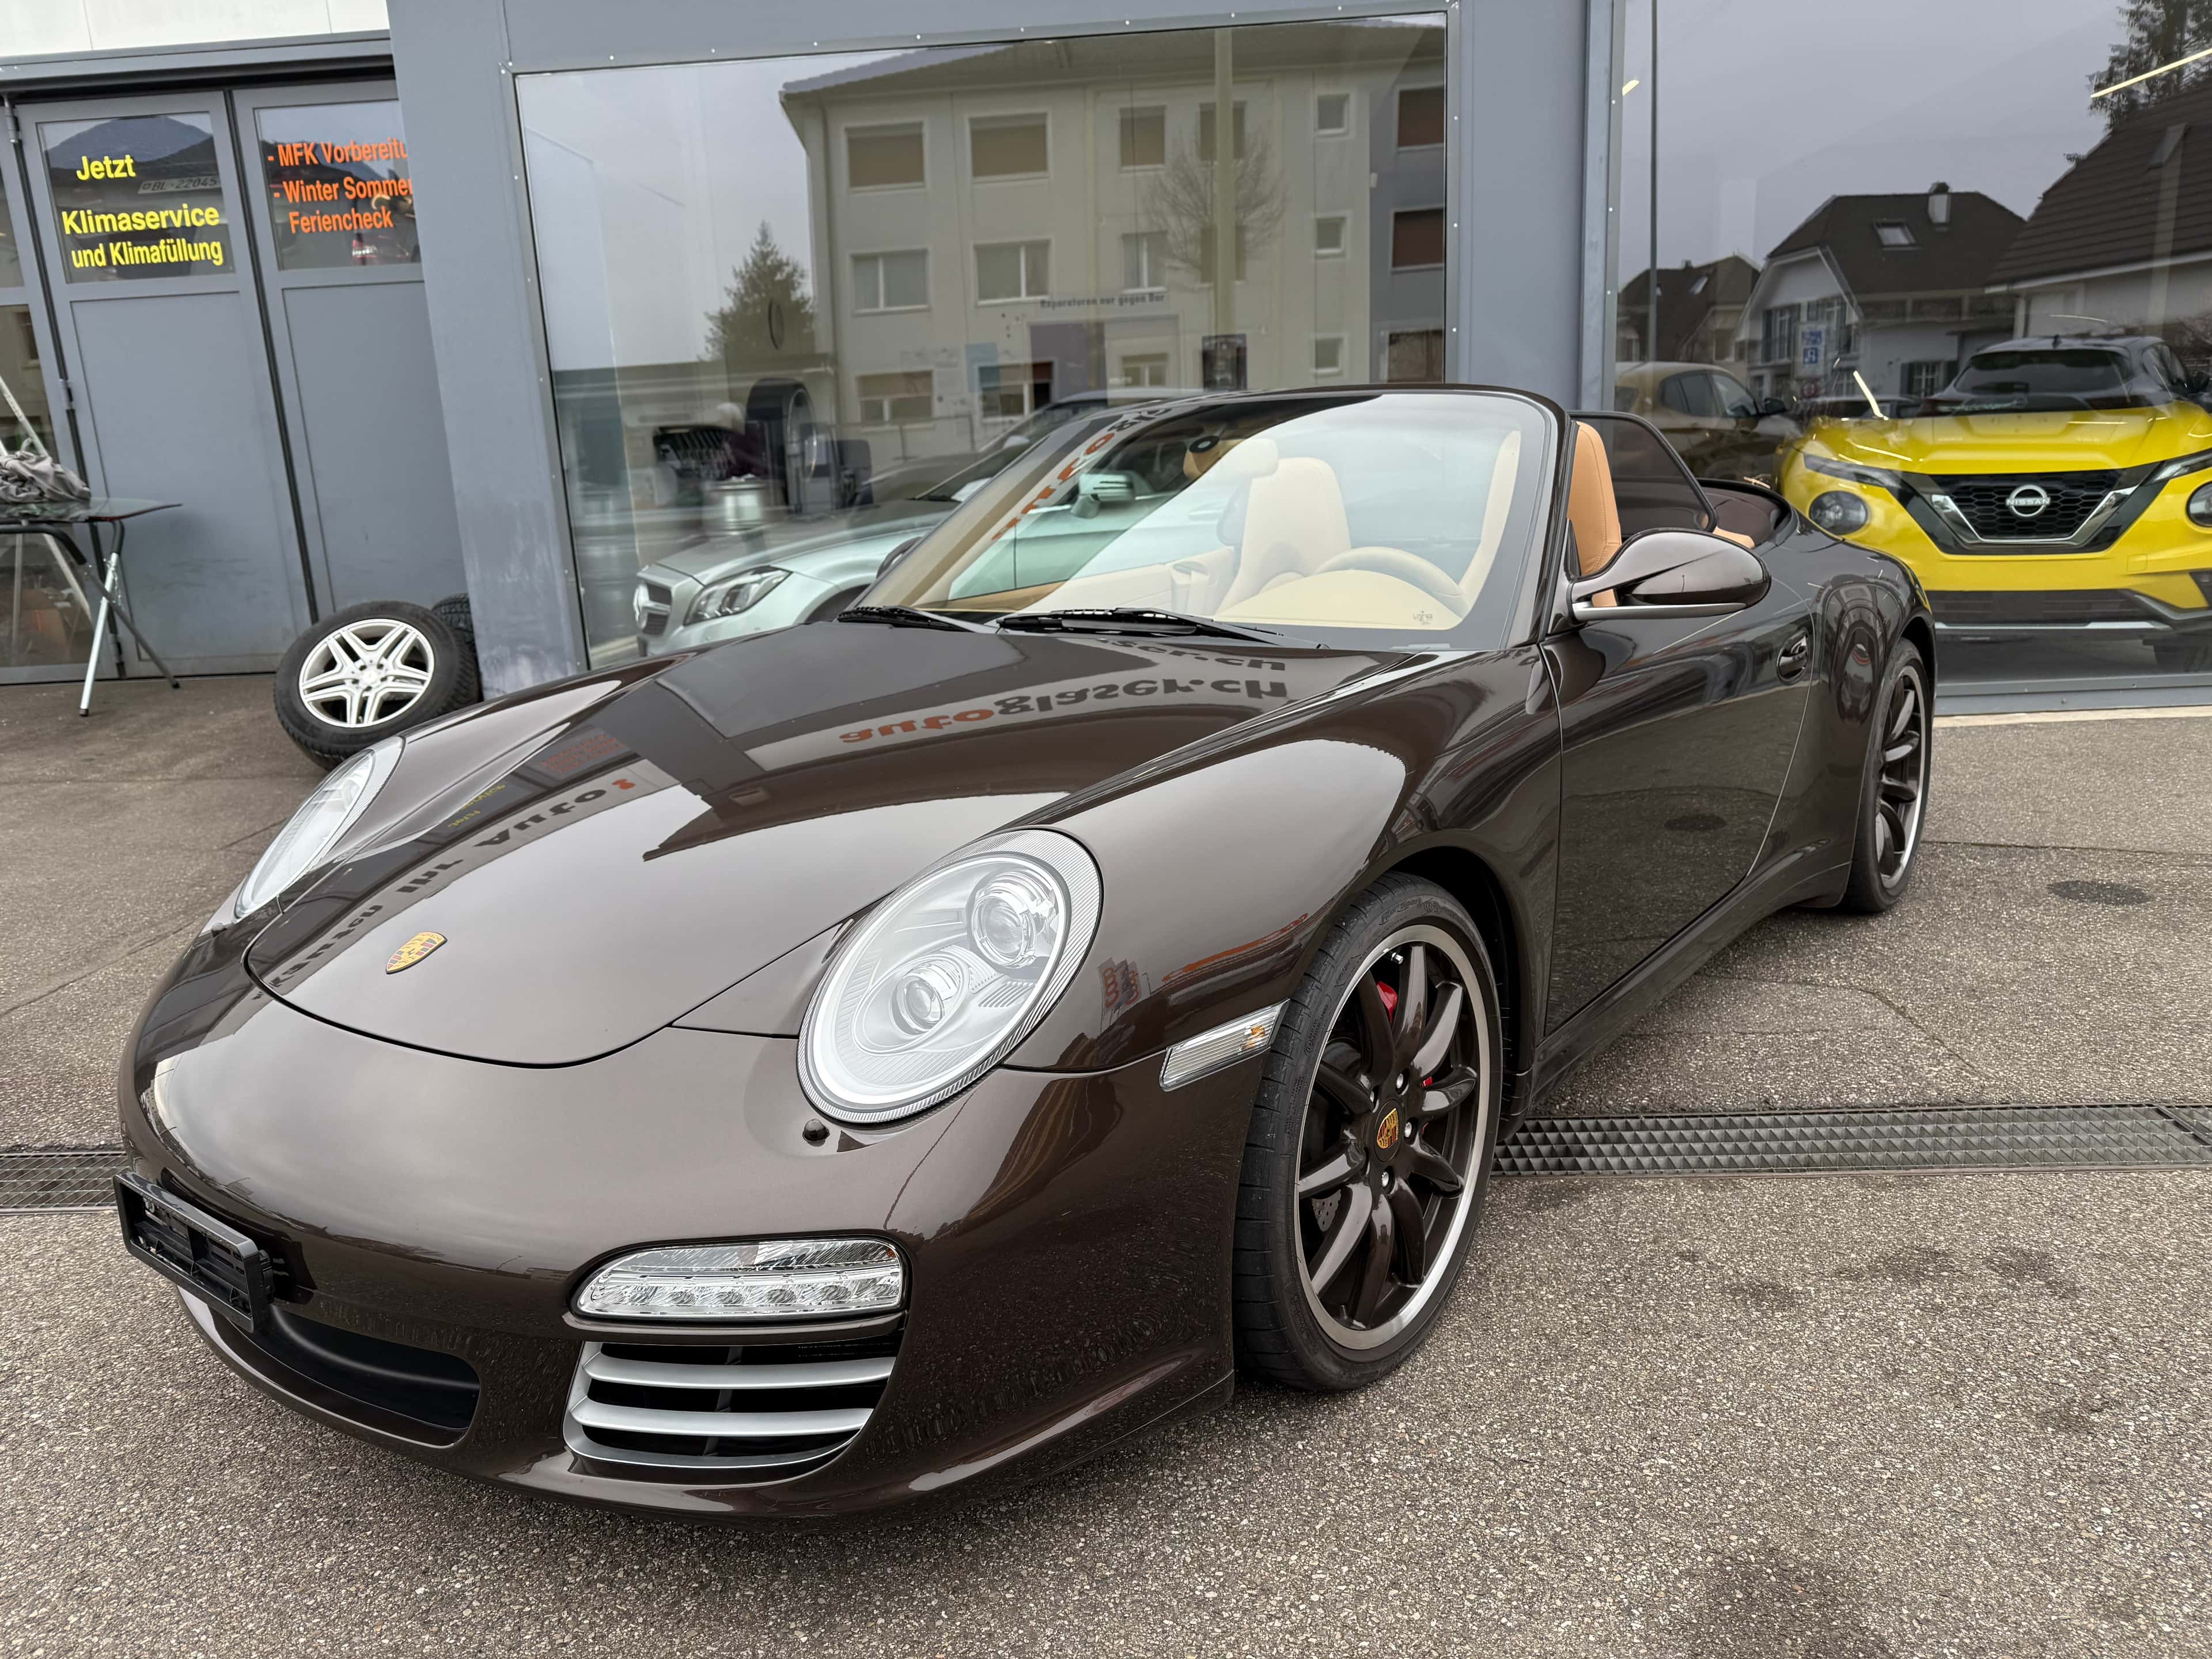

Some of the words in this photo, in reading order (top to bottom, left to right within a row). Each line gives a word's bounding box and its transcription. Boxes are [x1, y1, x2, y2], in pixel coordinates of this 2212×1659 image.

[76, 154, 136, 180] Jetzt
[277, 142, 319, 166] MFK
[282, 180, 339, 203] Winter
[61, 203, 219, 235] Klimaservice
[288, 205, 394, 234] Feriencheck
[71, 243, 107, 268] und
[109, 238, 224, 266] Klimafüllung
[2005, 497, 2051, 506] NISSAN
